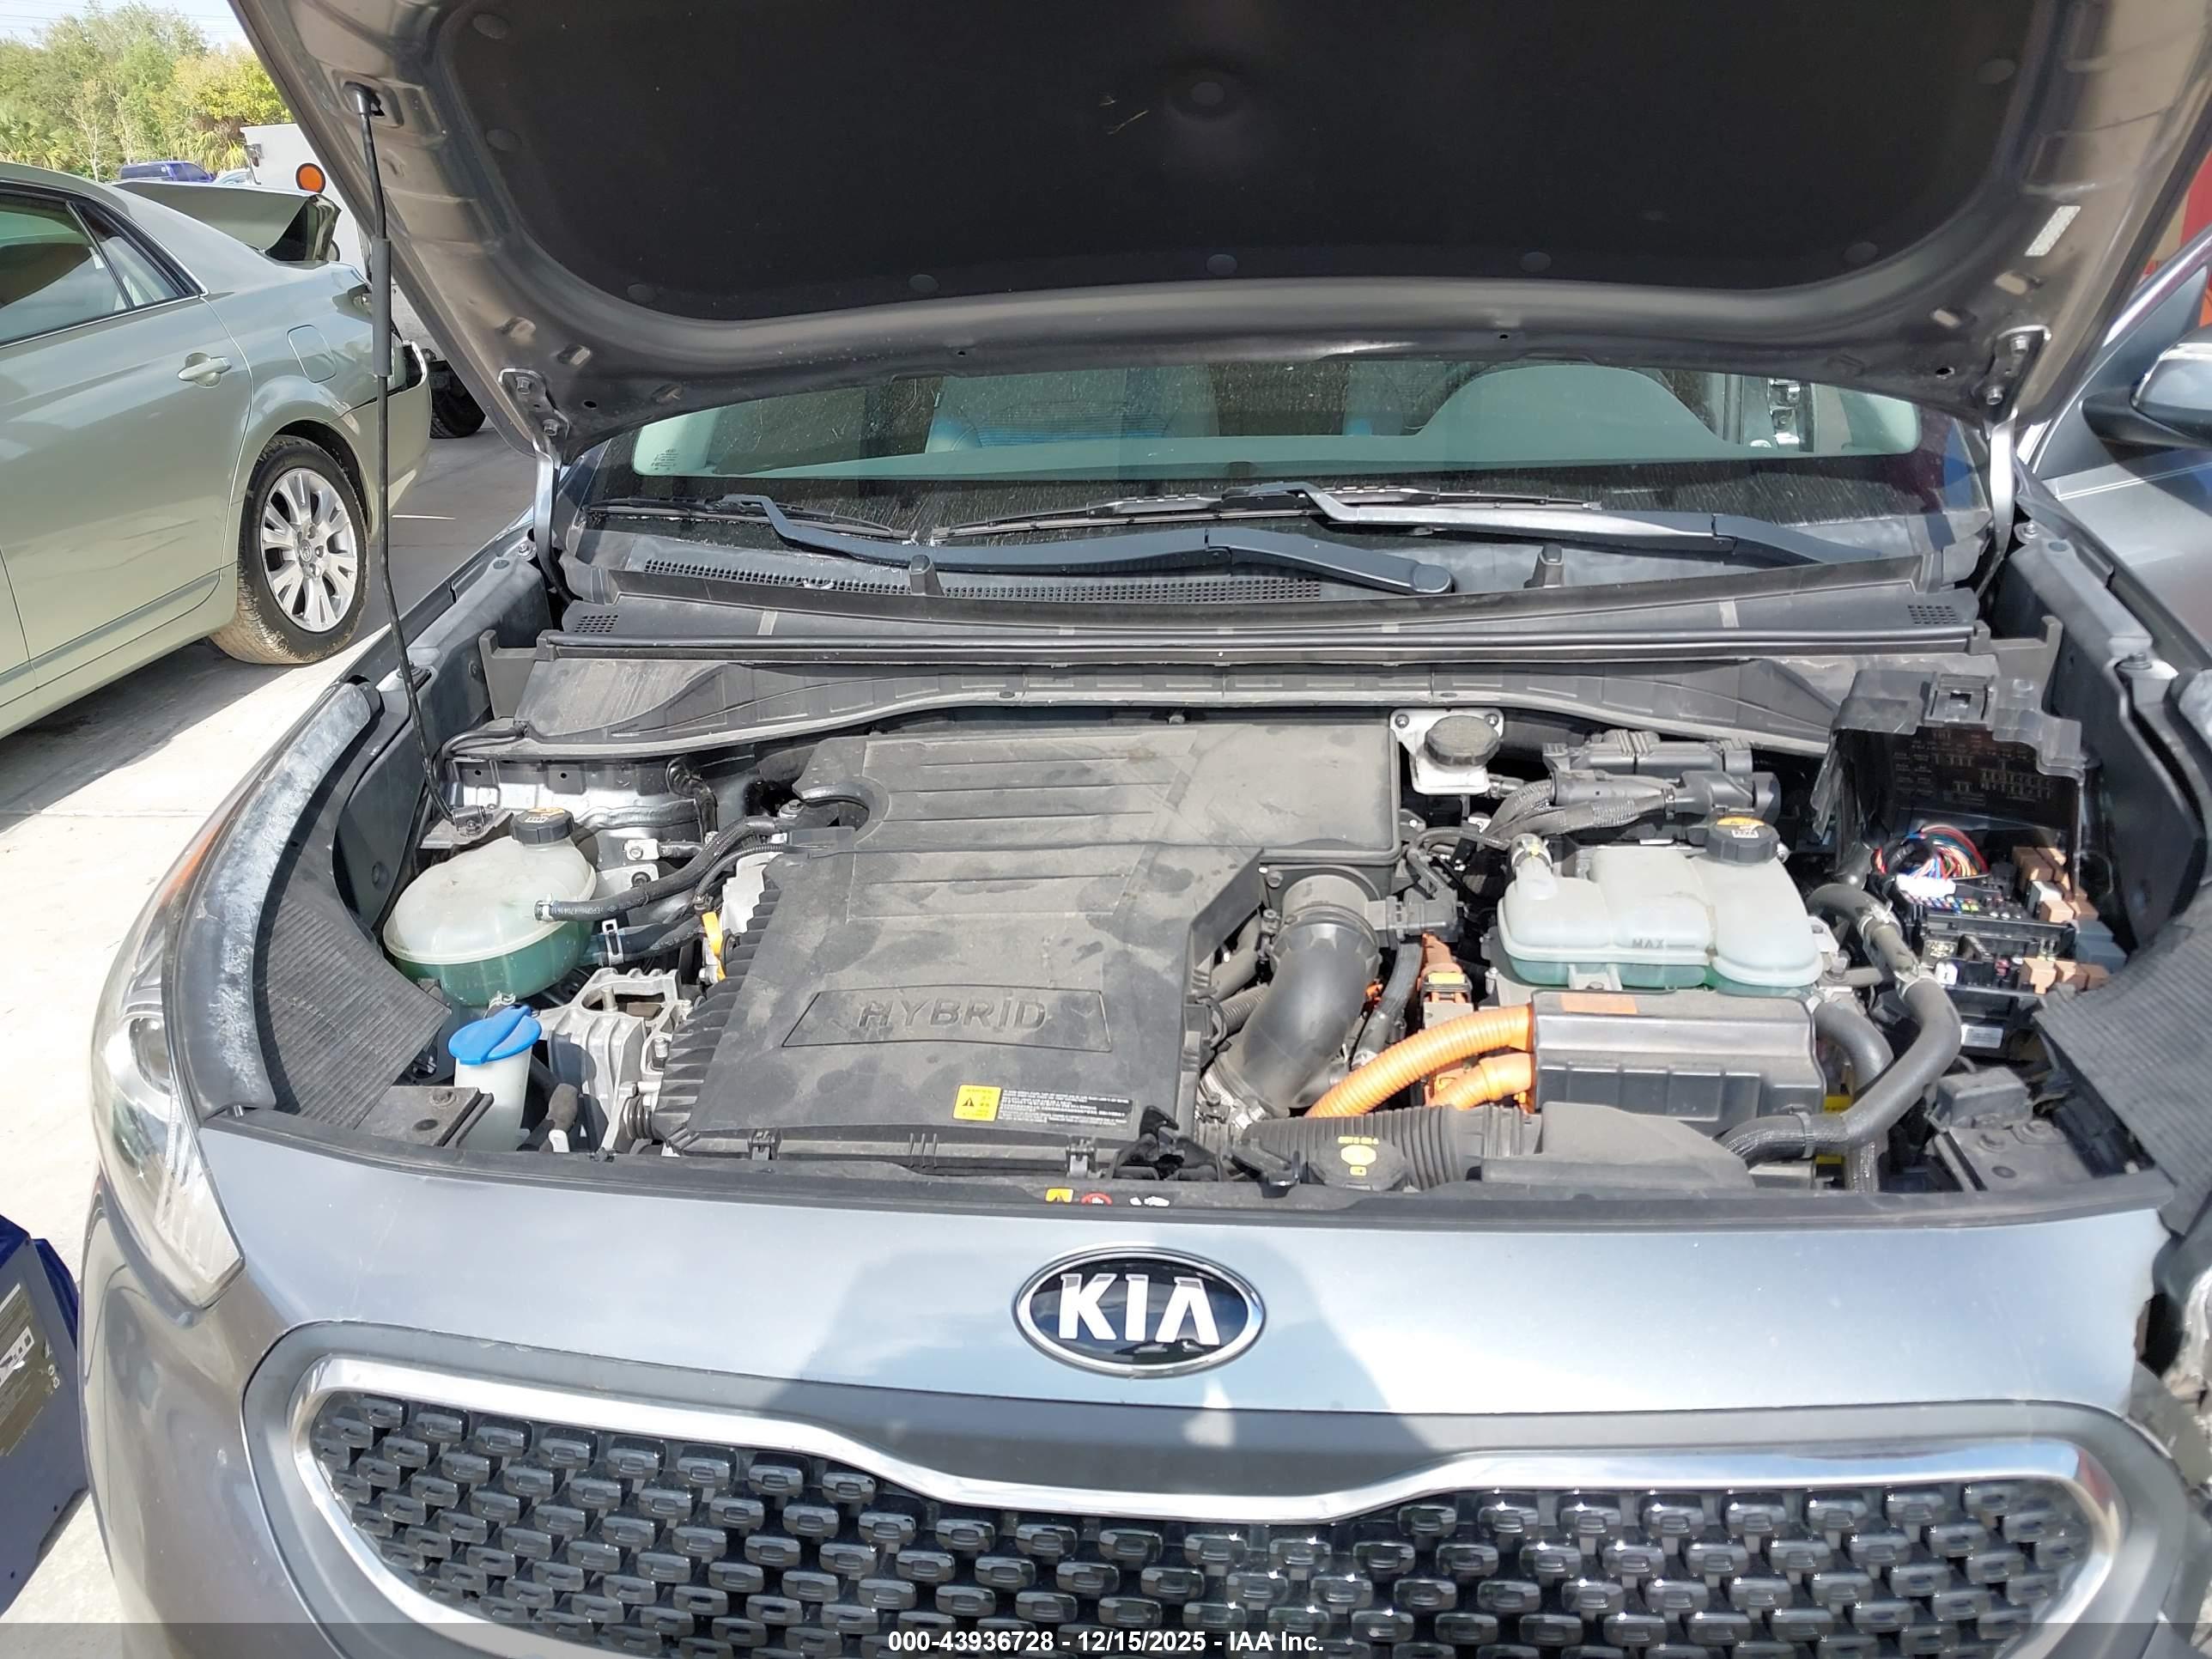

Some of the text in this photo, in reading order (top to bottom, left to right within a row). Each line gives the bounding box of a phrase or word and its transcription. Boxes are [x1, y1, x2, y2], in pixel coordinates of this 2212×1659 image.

[1632, 938, 1664, 949] MAX
[858, 996, 1047, 1031] HYBRID
[1059, 1273, 1220, 1346] KIA
